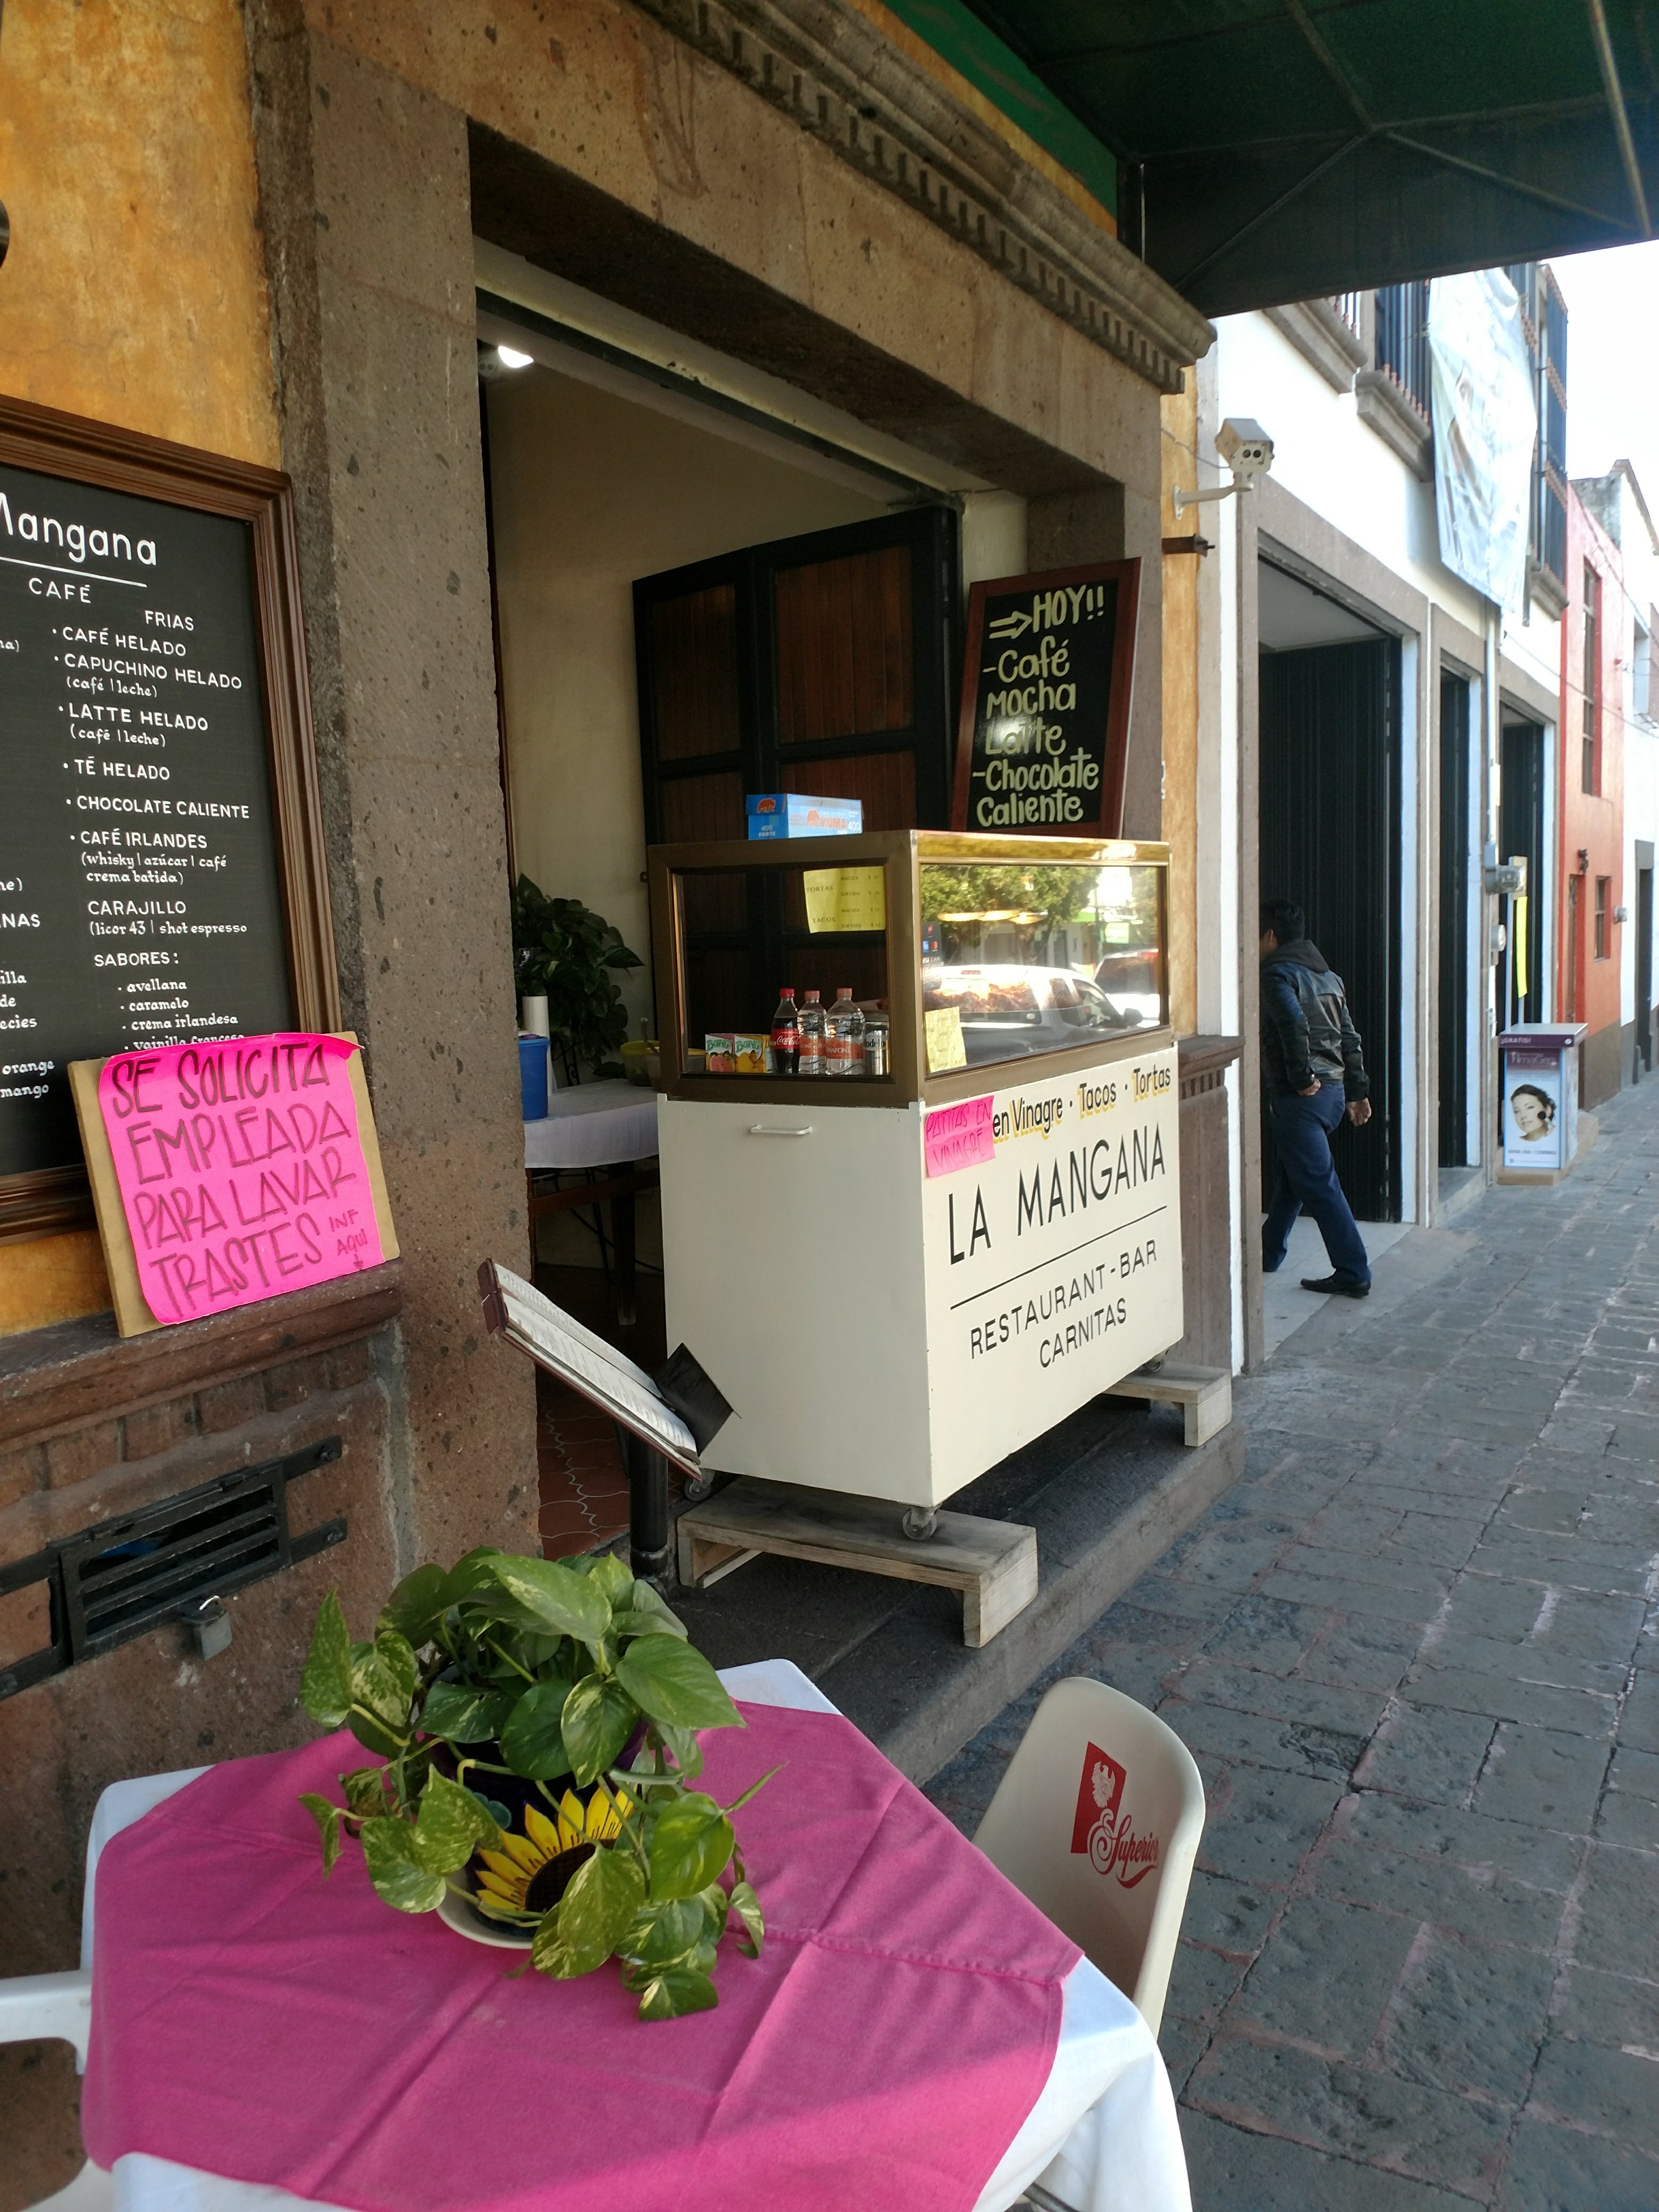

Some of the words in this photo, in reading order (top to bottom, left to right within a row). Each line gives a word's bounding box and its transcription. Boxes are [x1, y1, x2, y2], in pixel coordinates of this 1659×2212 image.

[29, 578, 91, 603] CAFÉ
[145, 610, 194, 631] FRIAS
[1033, 585, 1104, 633] HOY!!
[63, 627, 108, 645] CAFÉ
[115, 634, 186, 656] HELADO
[64, 653, 167, 682] CAPUCHINO
[175, 668, 241, 689] HELADO
[69, 702, 131, 723] LATTE
[140, 711, 208, 731] HELADO
[74, 756, 96, 775] TÉ
[103, 762, 170, 780] HELADO
[77, 795, 171, 814] CHOCOLATE
[177, 801, 249, 818] CALIENTE
[977, 789, 1084, 827] Caliente
[80, 828, 121, 845] CAFÉ
[126, 832, 207, 848] IRLANDES
[199, 855, 226, 872] café
[86, 873, 130, 882] crema
[88, 901, 186, 915] CARAJILLO
[129, 920, 146, 935] 43
[160, 921, 188, 934] shot
[190, 925, 247, 937] espresso
[127, 978, 187, 992] avellana
[129, 997, 189, 1011] caramelo
[131, 1020, 172, 1030] crema
[175, 1012, 238, 1027] irlandesa
[865, 1038, 885, 1048] odelo
[2, 1061, 55, 1076] orange
[111, 1058, 163, 1117] SE
[178, 1043, 330, 1109] SOLICITA
[0, 1085, 48, 1098] mango
[993, 1111, 1009, 1138] en
[1011, 1096, 1063, 1135] Vinagre
[1079, 1081, 1117, 1115] Tacos
[1133, 1064, 1171, 1097] Tortas
[976, 1099, 993, 1125] EN
[127, 1100, 352, 1185] EMPLEADA
[132, 1184, 227, 1250] PARA
[230, 1147, 356, 1226] LAVAR
[949, 1184, 992, 1266] LA
[1018, 1122, 1166, 1237] MANGANA
[328, 1209, 358, 1230] INF
[336, 1228, 368, 1254] AQUI
[149, 1212, 322, 1317] TRASTES
[1040, 1297, 1127, 1368] CARNITAS
